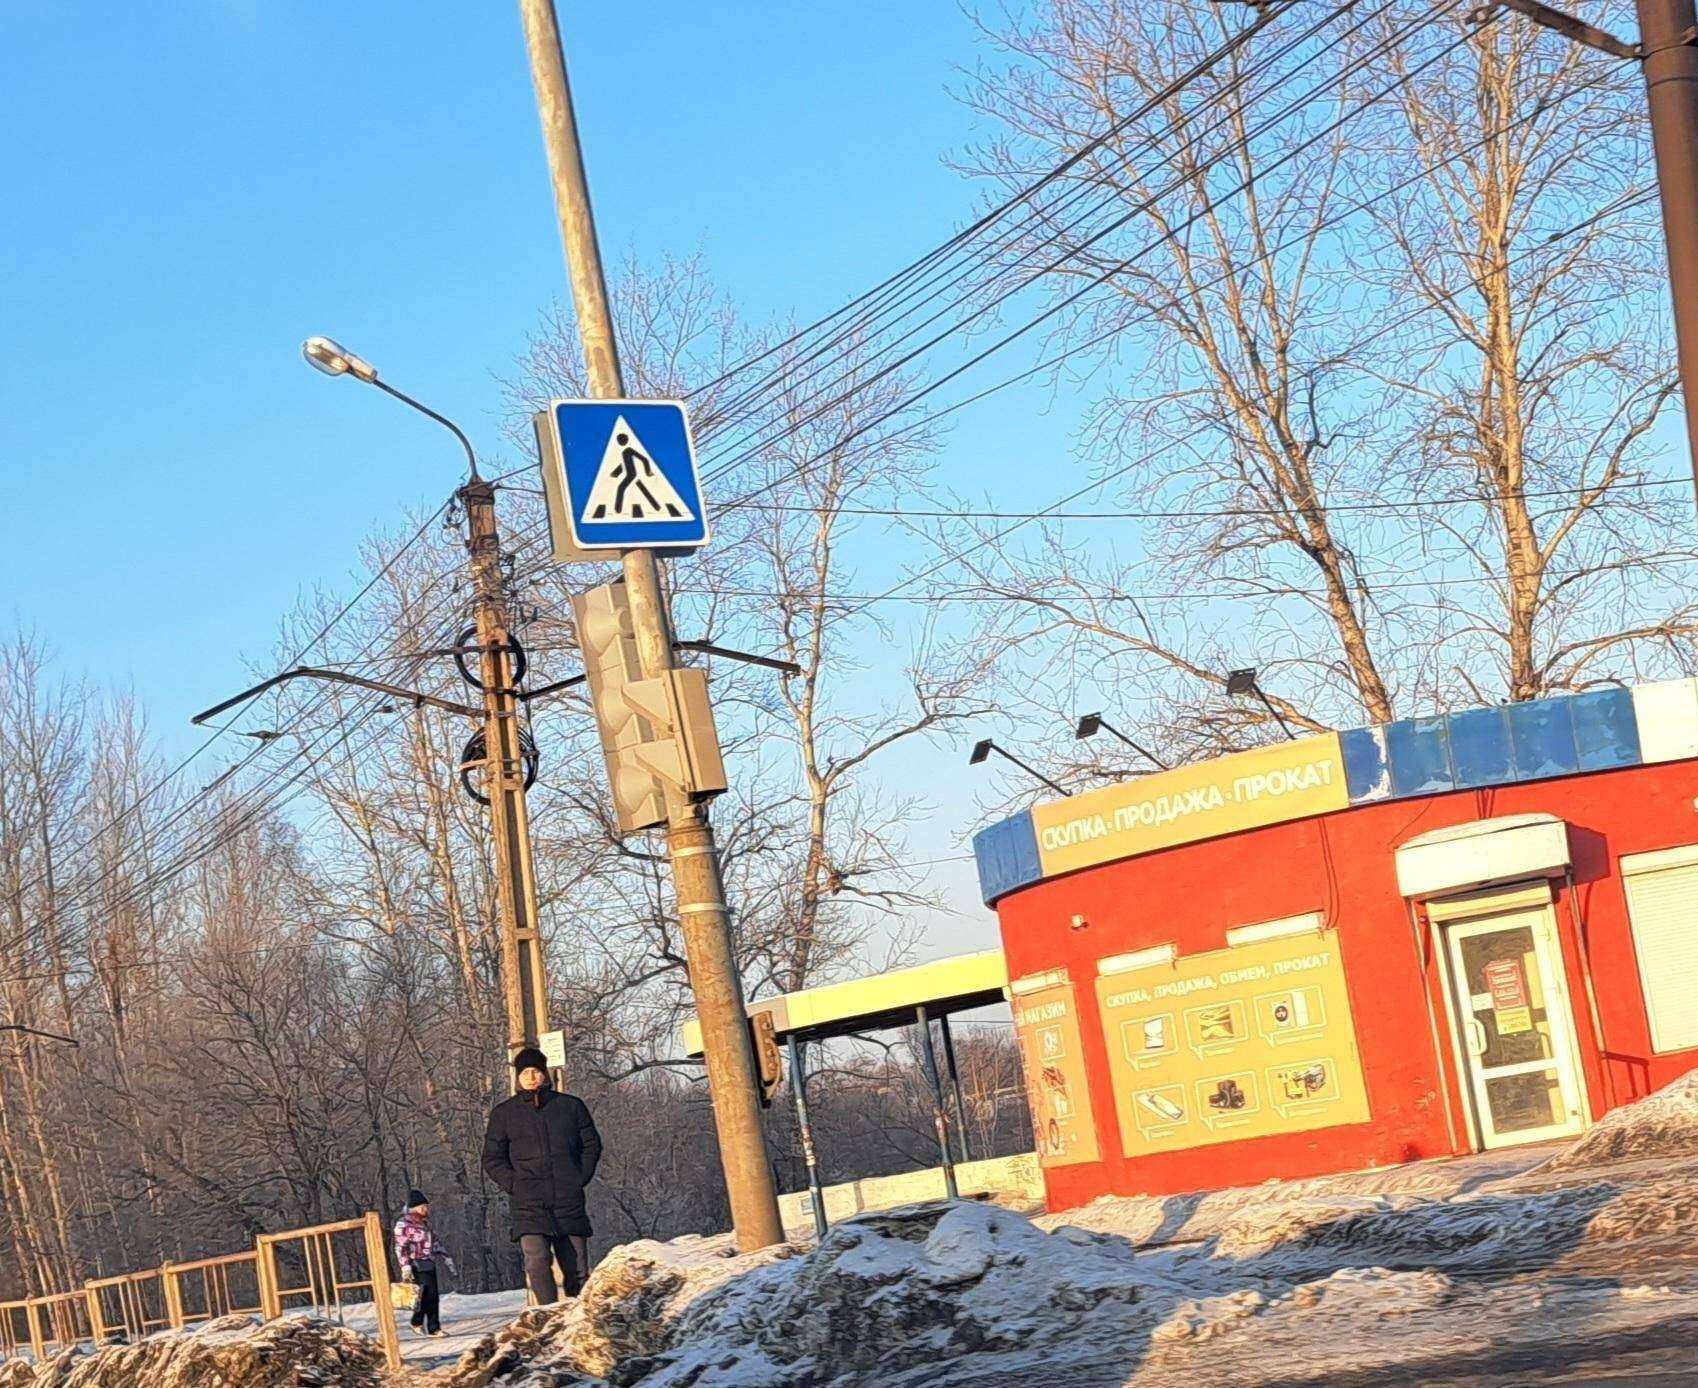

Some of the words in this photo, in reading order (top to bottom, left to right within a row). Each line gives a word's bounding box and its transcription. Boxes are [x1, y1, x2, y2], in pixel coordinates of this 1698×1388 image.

[1042, 814, 1108, 851] СКУПКА
[1112, 784, 1225, 832] ПРОДАЖА
[1232, 760, 1334, 804] ПРОКАТ
[1273, 952, 1331, 975] ПРОКАТ
